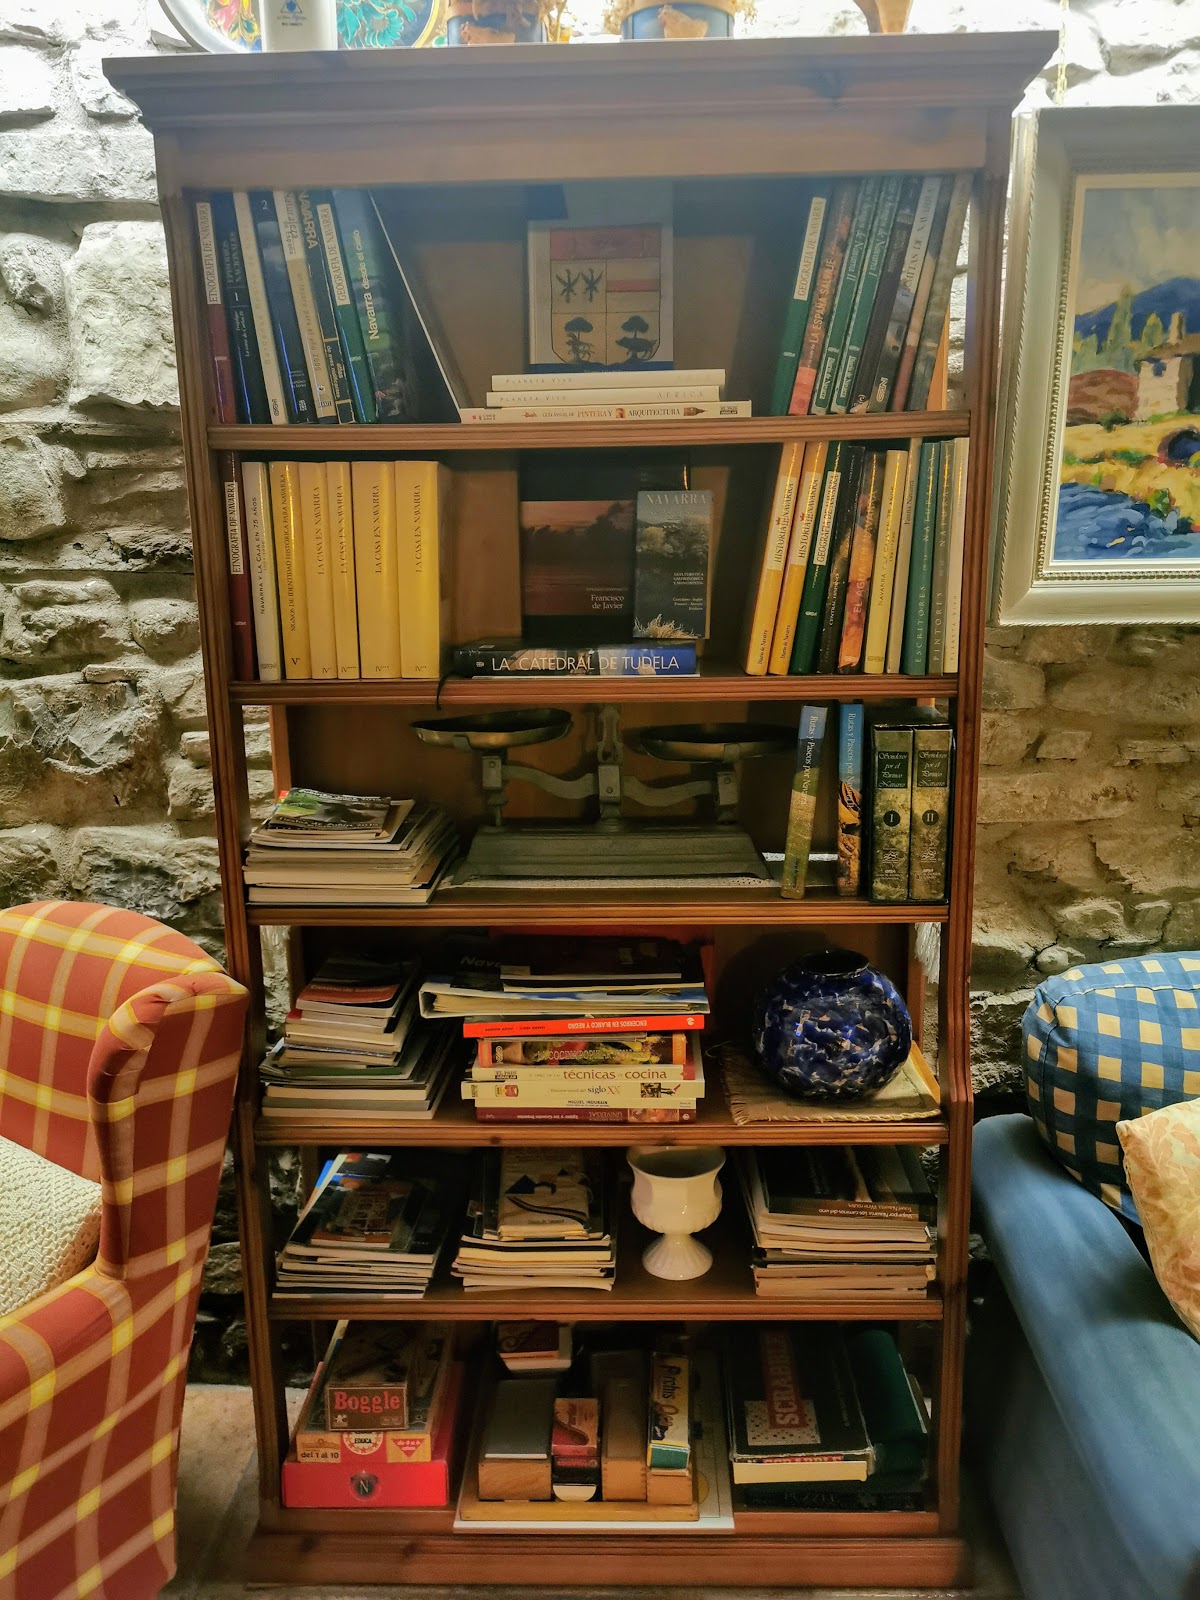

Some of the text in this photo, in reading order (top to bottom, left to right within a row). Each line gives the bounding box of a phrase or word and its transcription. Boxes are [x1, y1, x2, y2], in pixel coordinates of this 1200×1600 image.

[262, 200, 268, 210] 2
[855, 229, 866, 238] de
[877, 229, 887, 238] de
[199, 204, 218, 303] ETNOGRAFIA DE NAVARRA
[320, 207, 347, 301] GEOGRAFIA DE NAVARRA
[357, 252, 366, 261] el
[797, 201, 823, 297] GEOGRAFIA DE NAVARRA
[848, 240, 864, 272] Navarra
[869, 239, 885, 271] Navarra
[360, 262, 371, 290] desde
[363, 292, 380, 340] Navarra
[812, 297, 828, 330] ESPAÑA
[809, 332, 820, 344] LA
[312, 354, 321, 371] 2000
[628, 408, 680, 418] ARQUITECTURA
[279, 473, 287, 505] NAVARRA
[372, 485, 381, 523] NAVARRA
[647, 493, 707, 505] NAVARRA
[903, 480, 915, 525] Fauna Navarra
[252, 519, 259, 529] 75
[773, 482, 794, 563] HISTORIA NAVARRA
[797, 479, 818, 559] HISTORIA NAVARRA
[816, 474, 839, 563] GEOGRAFIA DE NAVARRA
[862, 490, 878, 543] NAVARRA
[227, 482, 242, 573] ETNOGRAFIA DE NAVARRA
[254, 531, 260, 542] EN
[313, 486, 325, 575] LA CASA EN NAVARRA
[336, 485, 348, 574] LA CASA EN NAVARRA
[373, 526, 381, 538] EN
[413, 484, 423, 573] LA CASA EN NAVARRA
[860, 547, 870, 562] EN
[256, 564, 263, 574] LA
[374, 562, 382, 574] LA
[286, 560, 294, 597] IDENTIDAD
[854, 566, 868, 597] AGUA
[591, 594, 625, 602] Francisco
[877, 573, 887, 606] NAVARRA
[288, 597, 294, 607] DE
[591, 601, 624, 610] de Javier
[853, 601, 863, 613] EL
[914, 585, 926, 663] ESCRITORES
[933, 591, 943, 661] PINTORES
[760, 629, 768, 647] Navarra
[779, 646, 787, 659] Diario
[783, 624, 791, 641] Navarra
[492, 656, 679, 671] LA CATEDRAL DE TUDELA
[757, 651, 765, 665] Diario
[809, 715, 818, 735] Rutas
[847, 713, 856, 732] Rutas
[805, 741, 815, 764] Paseos
[847, 738, 855, 761] Paseos
[802, 765, 811, 778] por
[845, 762, 854, 774] por
[800, 779, 810, 805] Navarra
[846, 776, 855, 801] Navarra
[889, 813, 893, 823] I
[926, 813, 934, 822] II
[568, 1022, 585, 1030] NEGRO
[591, 1020, 611, 1029] BLANCO
[612, 1020, 619, 1029] EN
[619, 1019, 647, 1029] ENCIERROS
[563, 1068, 668, 1080] técnicas cocina
[587, 1085, 621, 1094] siglo XX
[334, 1391, 401, 1414] Boggle
[360, 1479, 370, 1494] N
